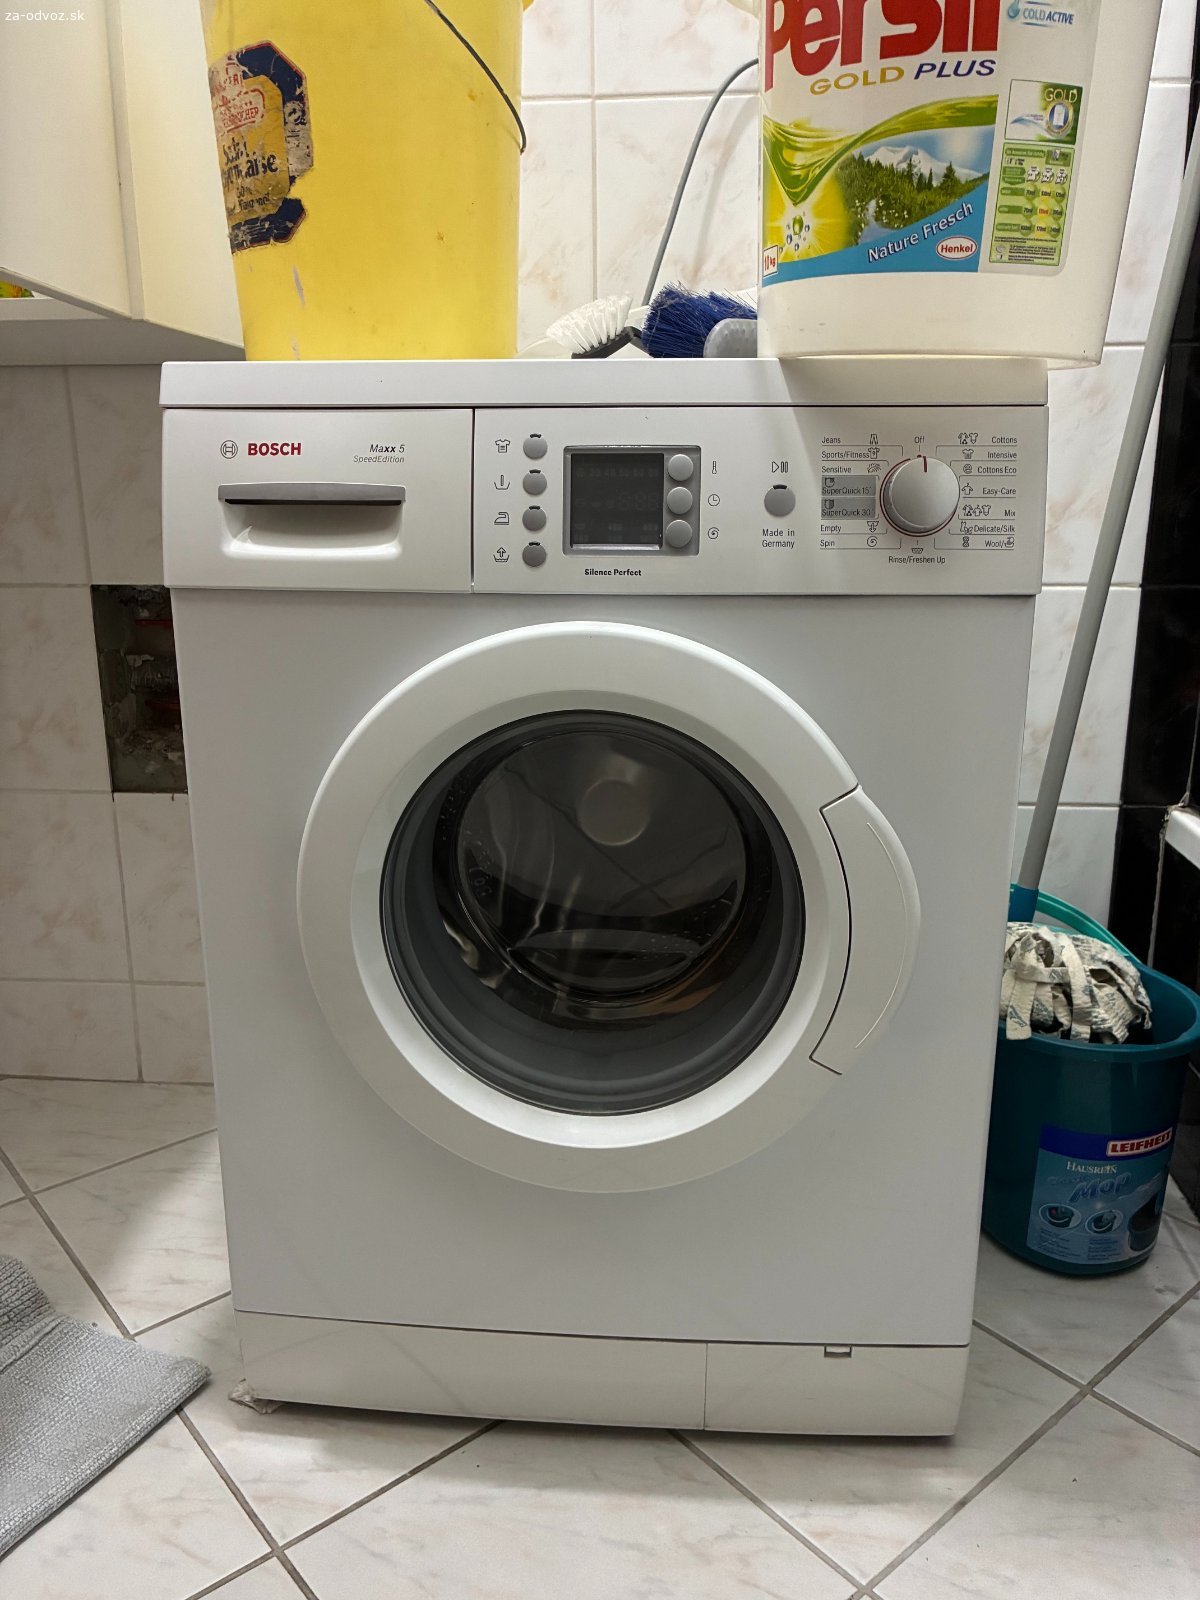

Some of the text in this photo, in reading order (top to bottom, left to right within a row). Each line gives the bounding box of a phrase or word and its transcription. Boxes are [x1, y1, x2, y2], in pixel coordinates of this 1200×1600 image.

[809, 59, 997, 96] GOLD PLUS
[1044, 87, 1078, 103] GOLD
[868, 201, 974, 263] Nature Fresch
[940, 239, 975, 254] Henkel
[821, 436, 841, 444] Jeans
[914, 435, 925, 443] Off
[991, 436, 1018, 444] Cottons
[247, 442, 302, 457] BOSCH
[369, 444, 405, 453] Maxx 5
[353, 455, 405, 463] SpeedEdition
[821, 450, 870, 459] Sports/Fitness
[987, 451, 1018, 459] Intensive
[821, 465, 852, 473] Sensitive
[977, 466, 1017, 474] Cottons Eco
[982, 487, 1017, 496] Easy-Care
[1004, 509, 1016, 517] Mix
[762, 528, 795, 537] Made in
[820, 524, 841, 533] Empty
[974, 525, 1015, 533] Delicate/Silk
[761, 540, 795, 549] Germany
[819, 539, 835, 548] Spin
[888, 555, 946, 564] Rinse/Freshen Up
[584, 568, 642, 576] Silence Perfect
[1110, 1131, 1171, 1153] LEIFHEIT
